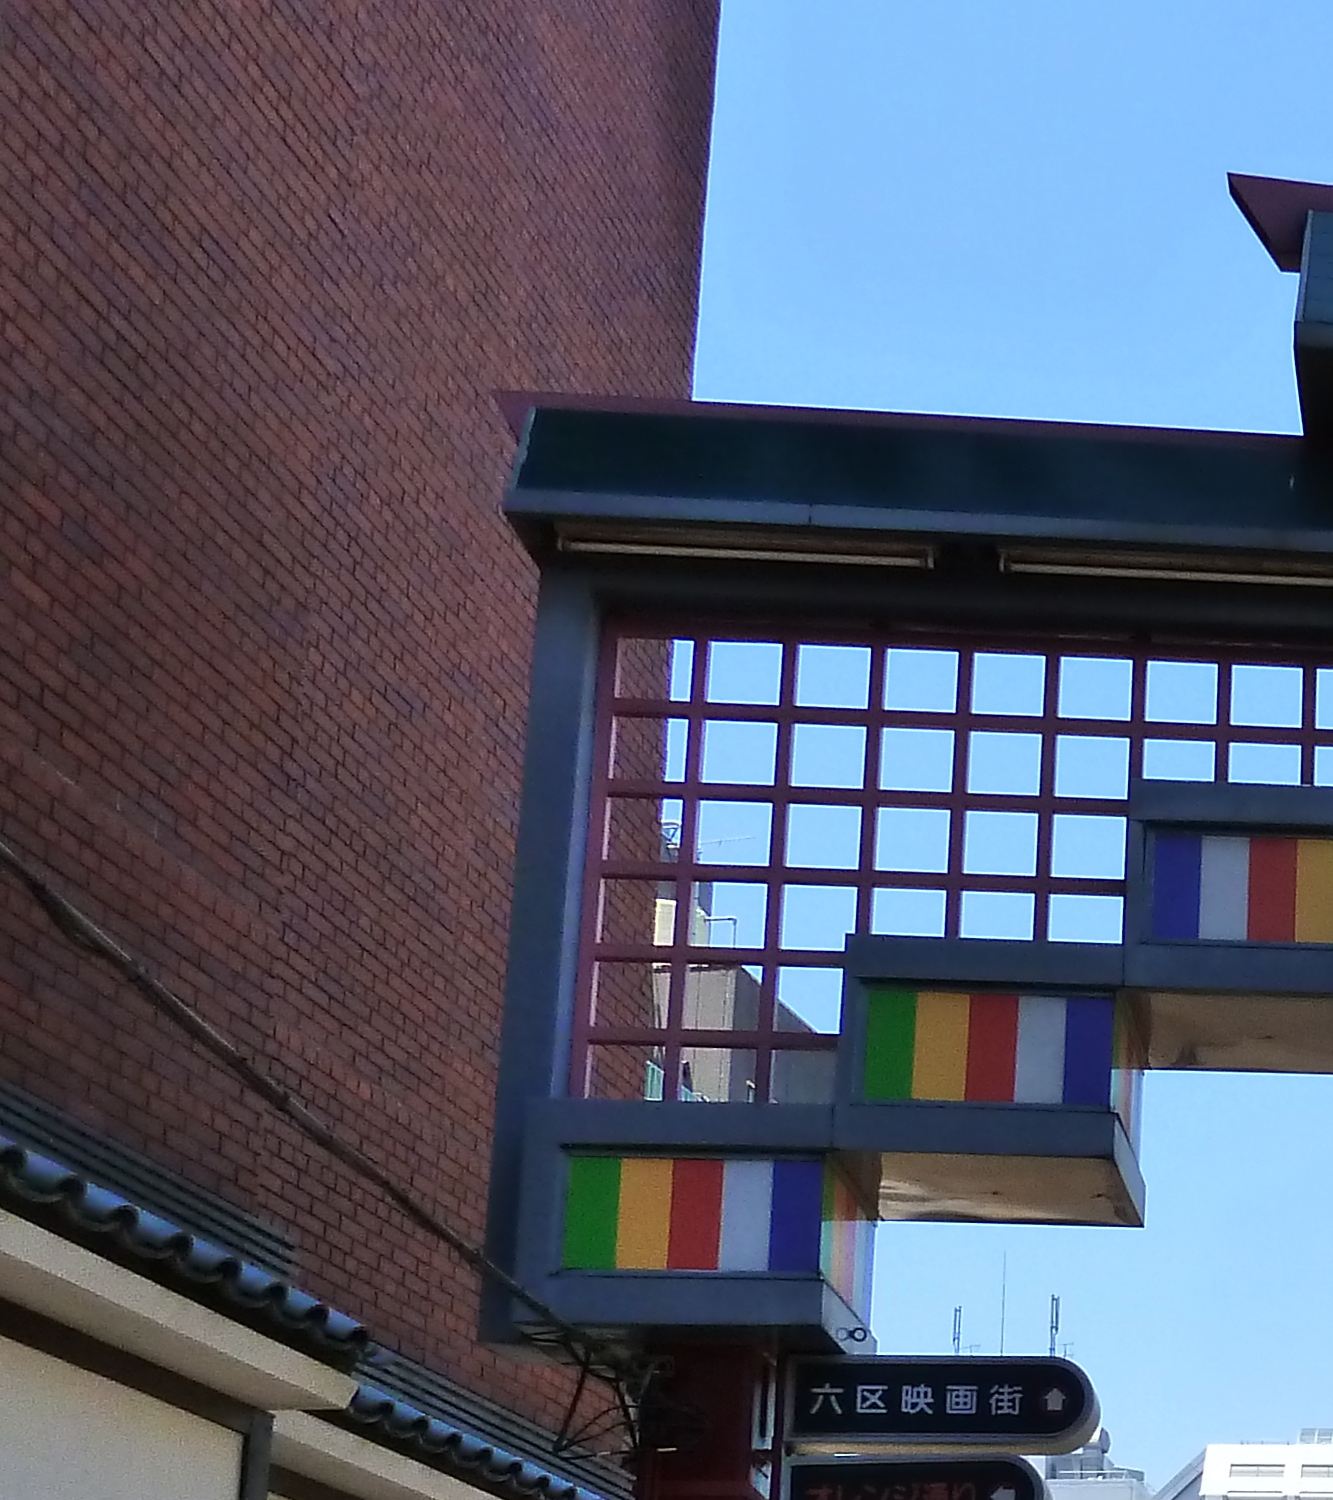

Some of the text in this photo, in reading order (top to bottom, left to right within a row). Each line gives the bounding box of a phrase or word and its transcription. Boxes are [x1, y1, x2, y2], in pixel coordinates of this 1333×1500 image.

[810, 1383, 1023, 1416] 六区映画街
